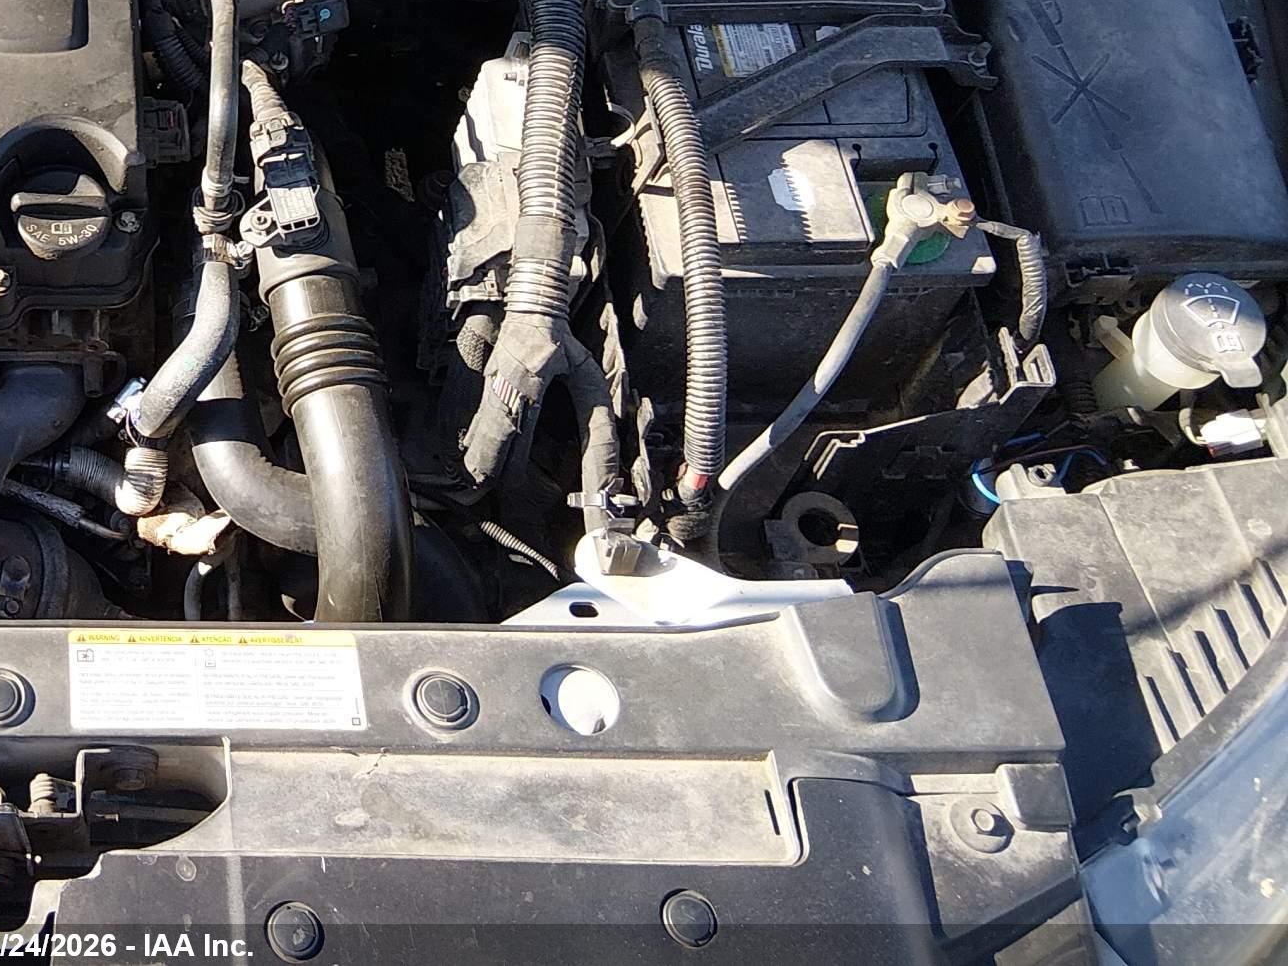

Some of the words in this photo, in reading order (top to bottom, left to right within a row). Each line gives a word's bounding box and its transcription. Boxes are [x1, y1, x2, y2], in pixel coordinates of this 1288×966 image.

[26, 224, 50, 242] SAE
[58, 224, 97, 246] 5W-30
[88, 634, 120, 642] WARNING
[139, 634, 183, 642] ADVERTENCIA
